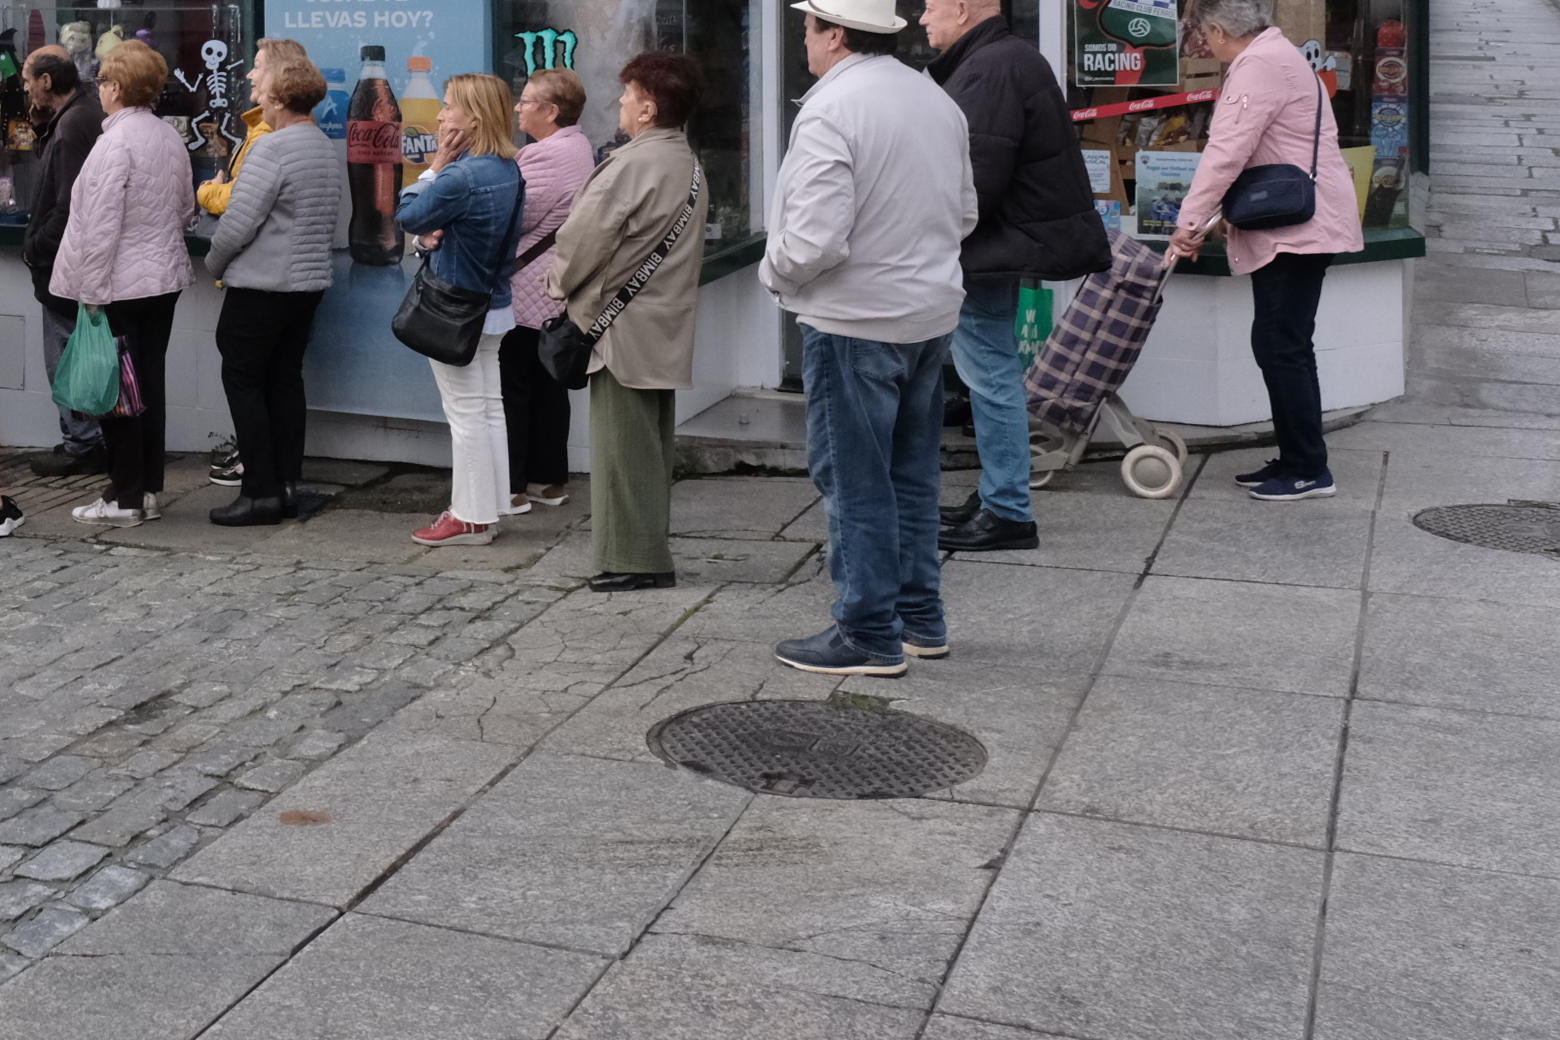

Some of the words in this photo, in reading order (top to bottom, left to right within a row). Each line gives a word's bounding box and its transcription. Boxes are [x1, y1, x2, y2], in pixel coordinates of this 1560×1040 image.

[284, 11, 368, 28] LLEVAS
[373, 10, 434, 28] HOY?
[1084, 43, 1107, 52] SOMOS
[1083, 53, 1142, 71] RACING
[1128, 99, 1155, 111] Coca-Cola
[1186, 90, 1213, 102] Coca-Cola
[664, 202, 694, 251] BIMBAY
[624, 251, 663, 298] BIMBAY
[589, 297, 626, 341] BIMBAY
